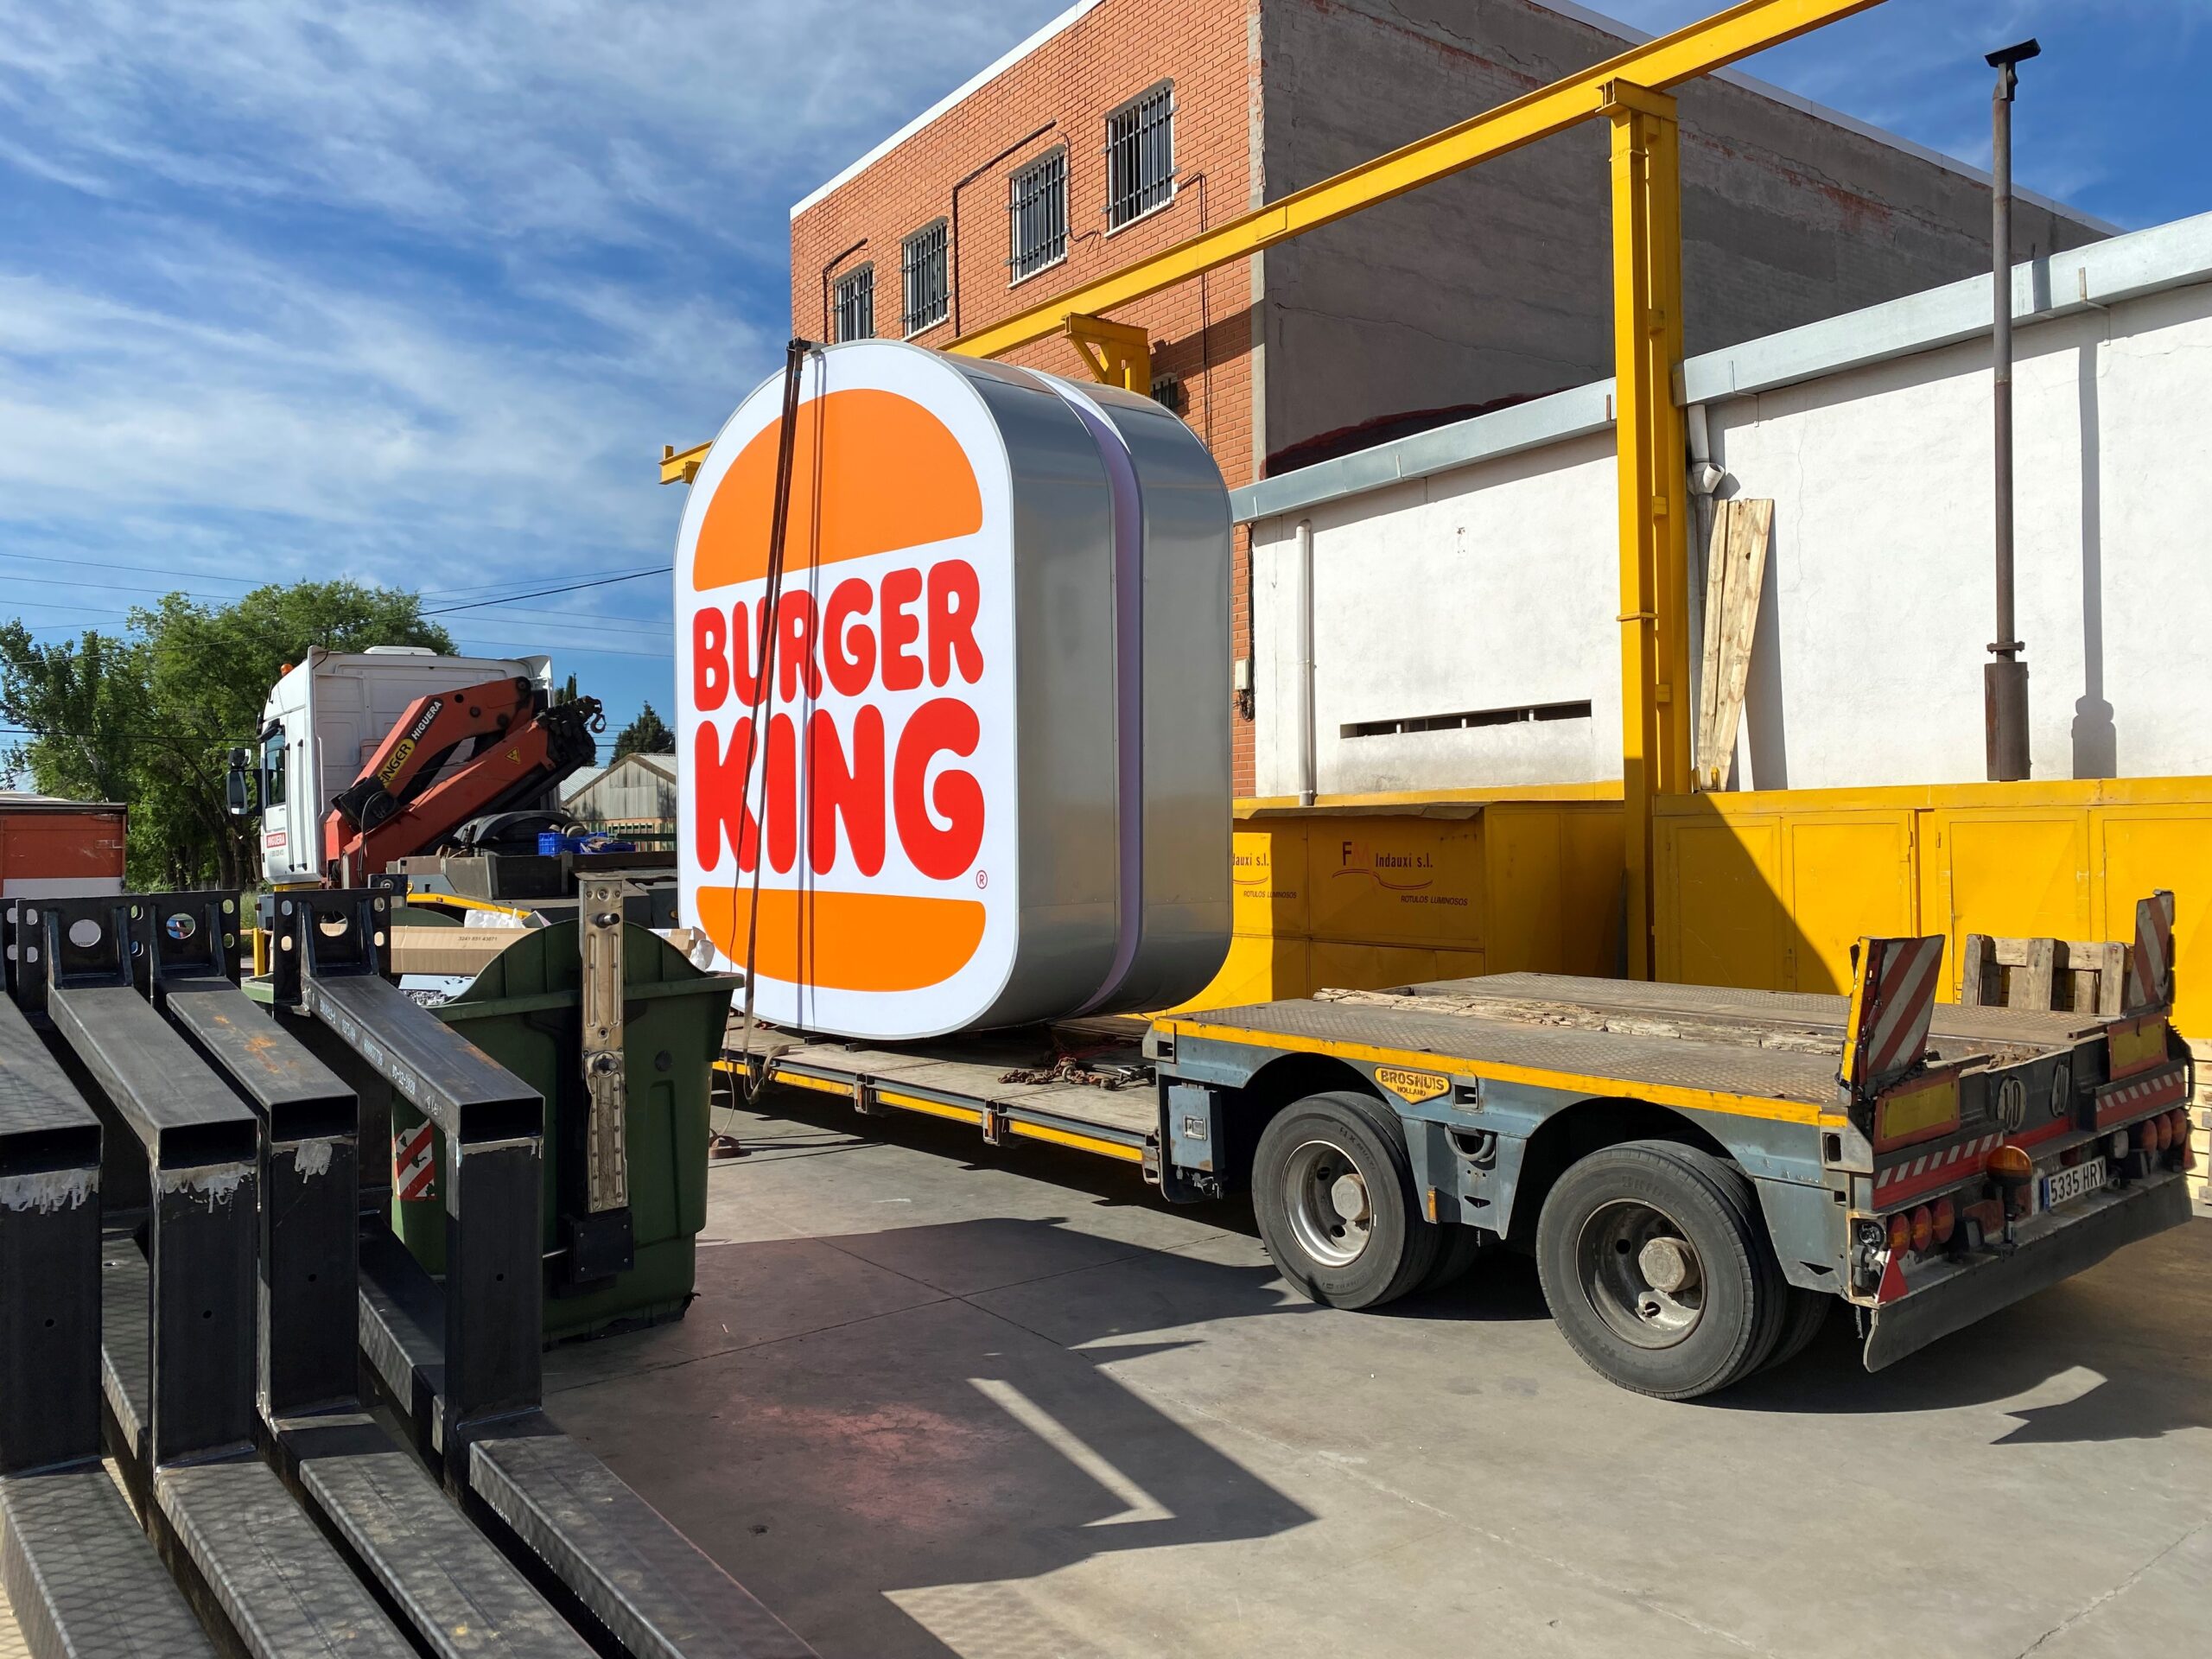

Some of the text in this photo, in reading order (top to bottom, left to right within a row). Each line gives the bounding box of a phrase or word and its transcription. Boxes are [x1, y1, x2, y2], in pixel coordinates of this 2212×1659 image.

[693, 559, 984, 711] BURGER
[411, 701, 442, 741] HIGUERA
[695, 697, 985, 880] KING
[1375, 852, 1412, 868] Indauxi
[1430, 896, 1468, 906] LUMINOSOS
[1380, 1070, 1445, 1091] BROSHUIS
[1396, 1084, 1427, 1096] HOLLAND
[2050, 1160, 2105, 1203] 5335 HRX
